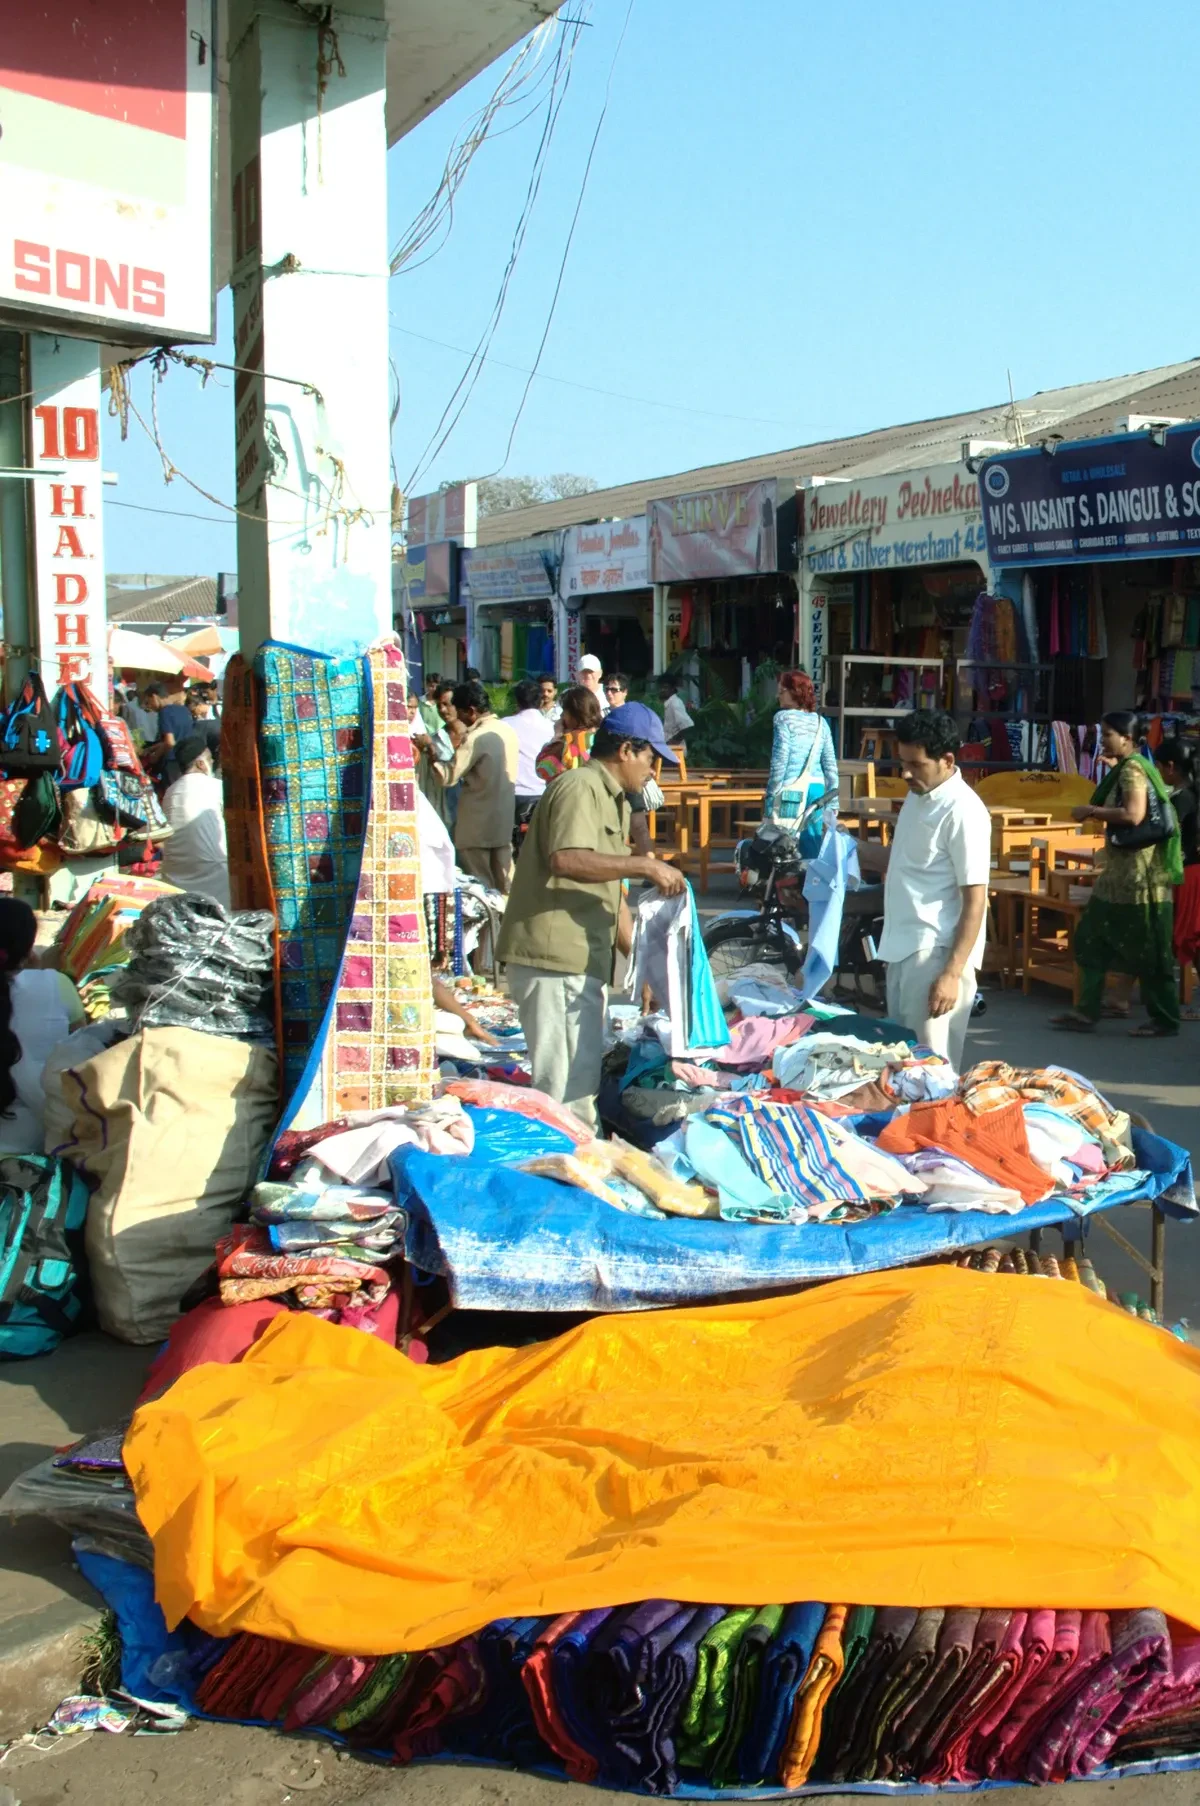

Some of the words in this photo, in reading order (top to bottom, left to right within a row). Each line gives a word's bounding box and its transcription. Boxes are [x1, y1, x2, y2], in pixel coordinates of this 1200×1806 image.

[14, 239, 165, 317] SONS
[34, 405, 99, 461] 10
[810, 488, 888, 536] Jewellery
[1021, 496, 1076, 532] VASANT
[1079, 494, 1094, 527] S.
[1096, 485, 1162, 525] DANGUI
[1165, 483, 1180, 518] &
[837, 543, 847, 571] &
[851, 537, 891, 569] Silver
[668, 612, 681, 624] 44
